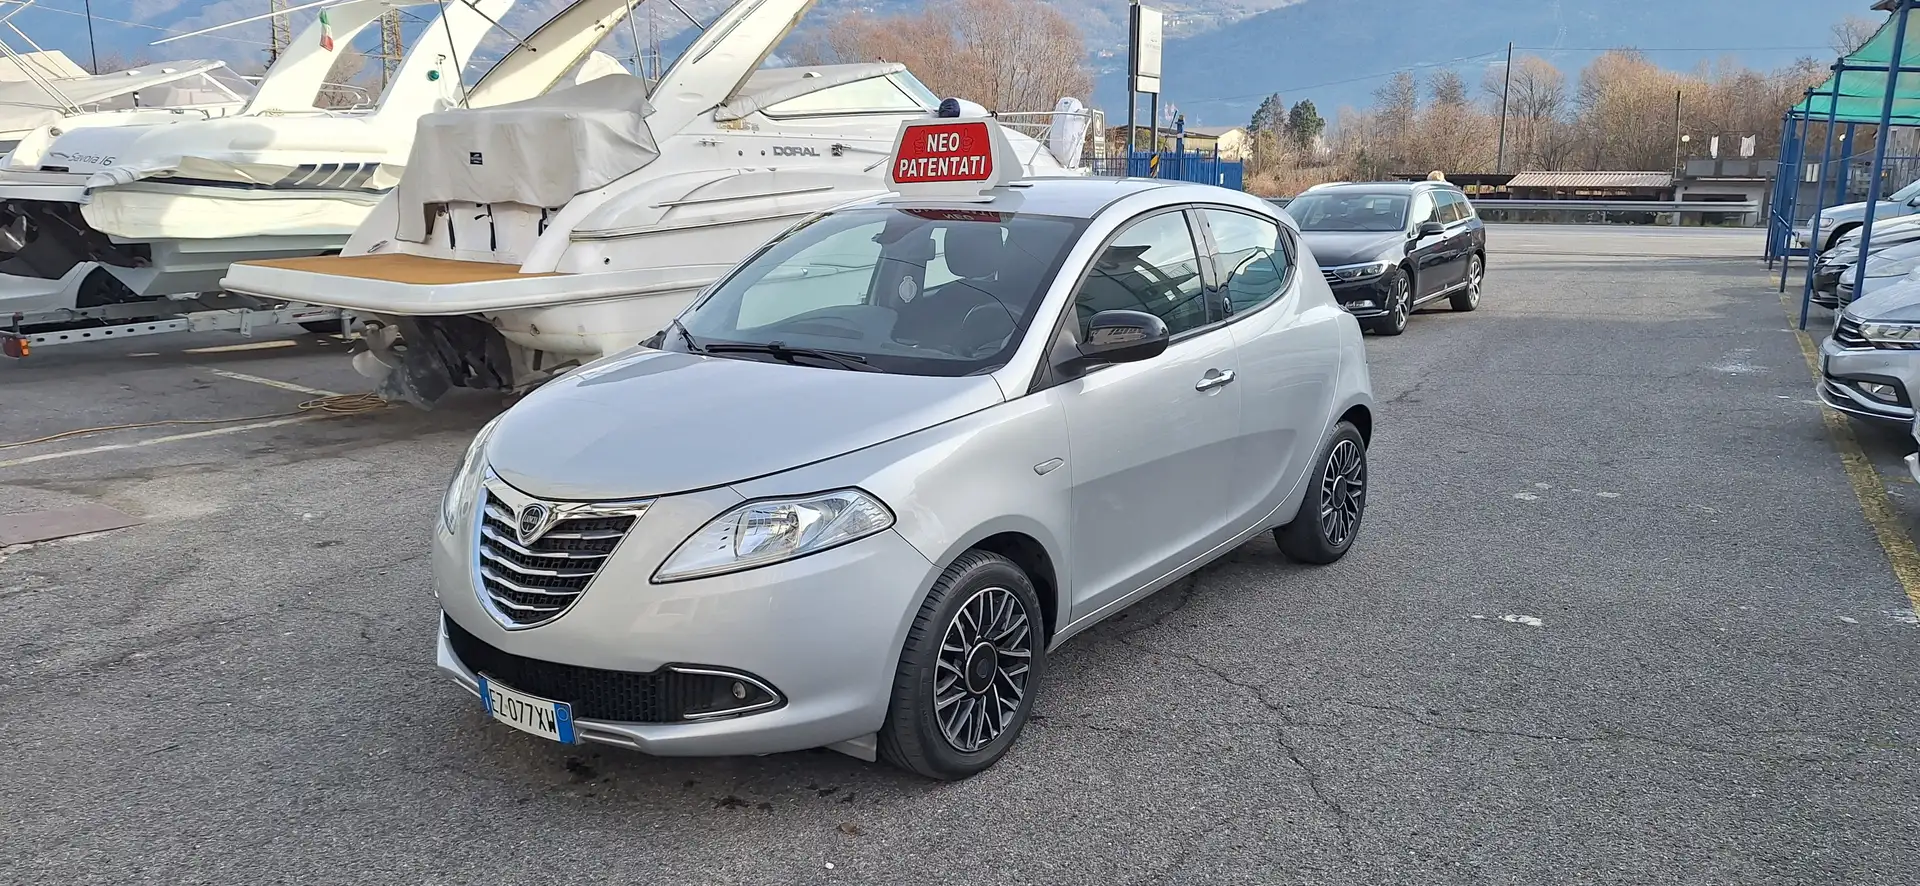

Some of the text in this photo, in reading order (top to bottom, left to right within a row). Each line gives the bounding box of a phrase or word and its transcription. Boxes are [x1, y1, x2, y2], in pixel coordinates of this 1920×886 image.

[773, 146, 820, 157] DORAL
[927, 132, 960, 152] NEO
[898, 155, 986, 178] PATENTATI
